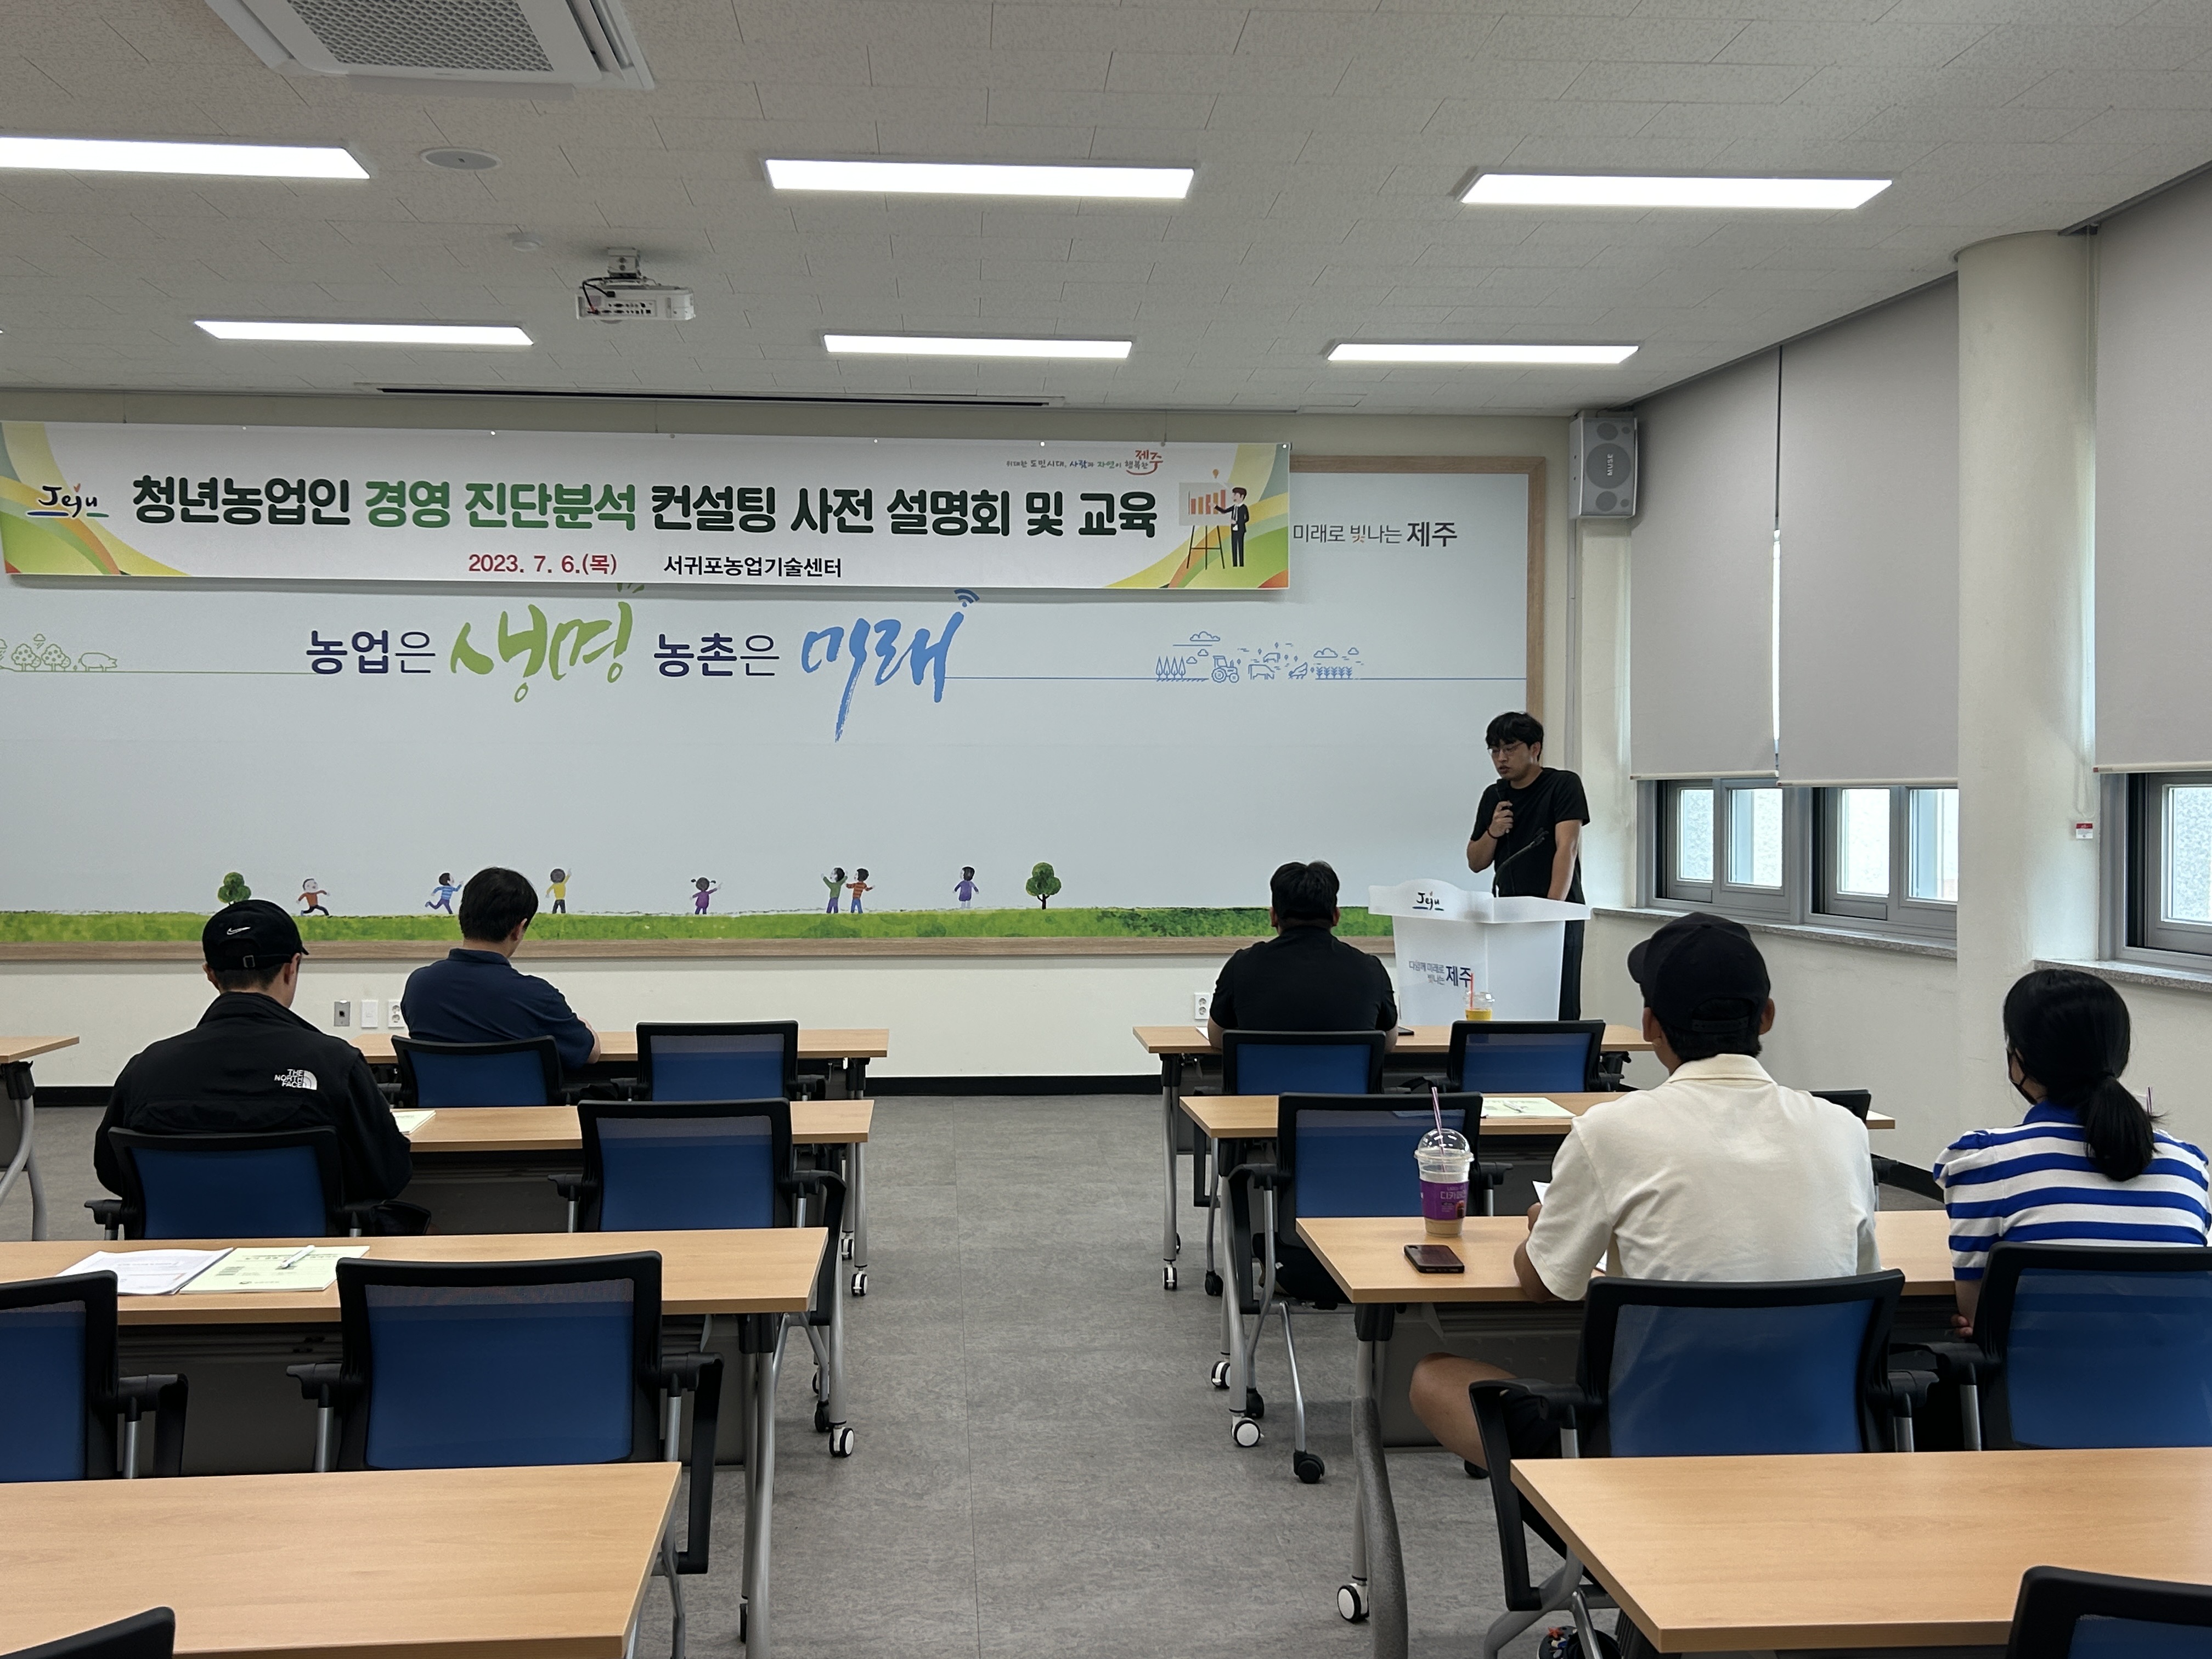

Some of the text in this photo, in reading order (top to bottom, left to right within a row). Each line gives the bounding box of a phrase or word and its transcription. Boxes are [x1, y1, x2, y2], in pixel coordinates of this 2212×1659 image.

[1030, 460, 1066, 469] 도민시대,
[1097, 460, 1122, 469] 자연이
[1134, 449, 1164, 474] 제주
[38, 483, 97, 518] Jeju
[133, 475, 1158, 538] 청년농업인 경영 진단분석 컨설팅 사전 설명회 및 교육
[1293, 521, 1458, 548] 미래로 빛나는 제주
[469, 553, 617, 575] 2023. 7. 6.(목)
[663, 555, 841, 578] 서귀포농업기술센터
[306, 601, 964, 742] 농업은 생명 농촌은 미래
[1416, 891, 1440, 911] Jeju
[1446, 966, 1471, 988] 제주
[274, 1074, 303, 1082] NORTH
